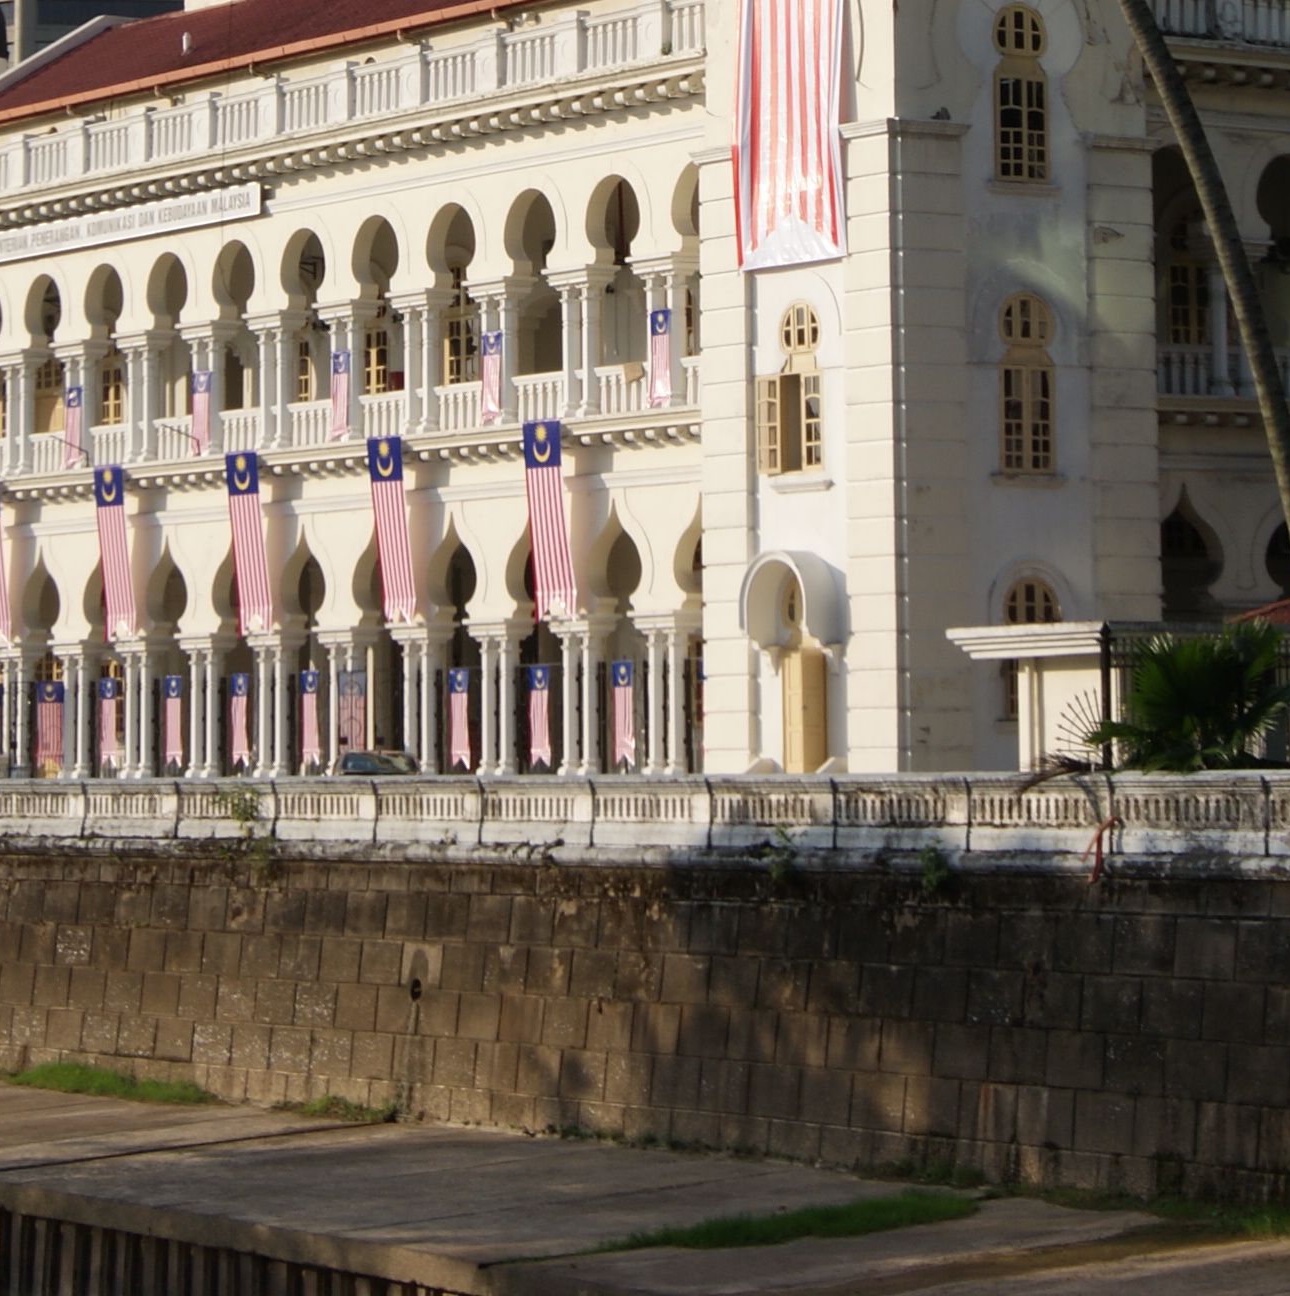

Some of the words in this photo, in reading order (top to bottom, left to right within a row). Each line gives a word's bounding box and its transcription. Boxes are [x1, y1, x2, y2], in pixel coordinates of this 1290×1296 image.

[86, 213, 136, 237] KOMUNIKASI
[138, 210, 155, 228] DAN
[158, 200, 208, 224] KEBUDAYAAN
[210, 191, 251, 214] MALAYSIA
